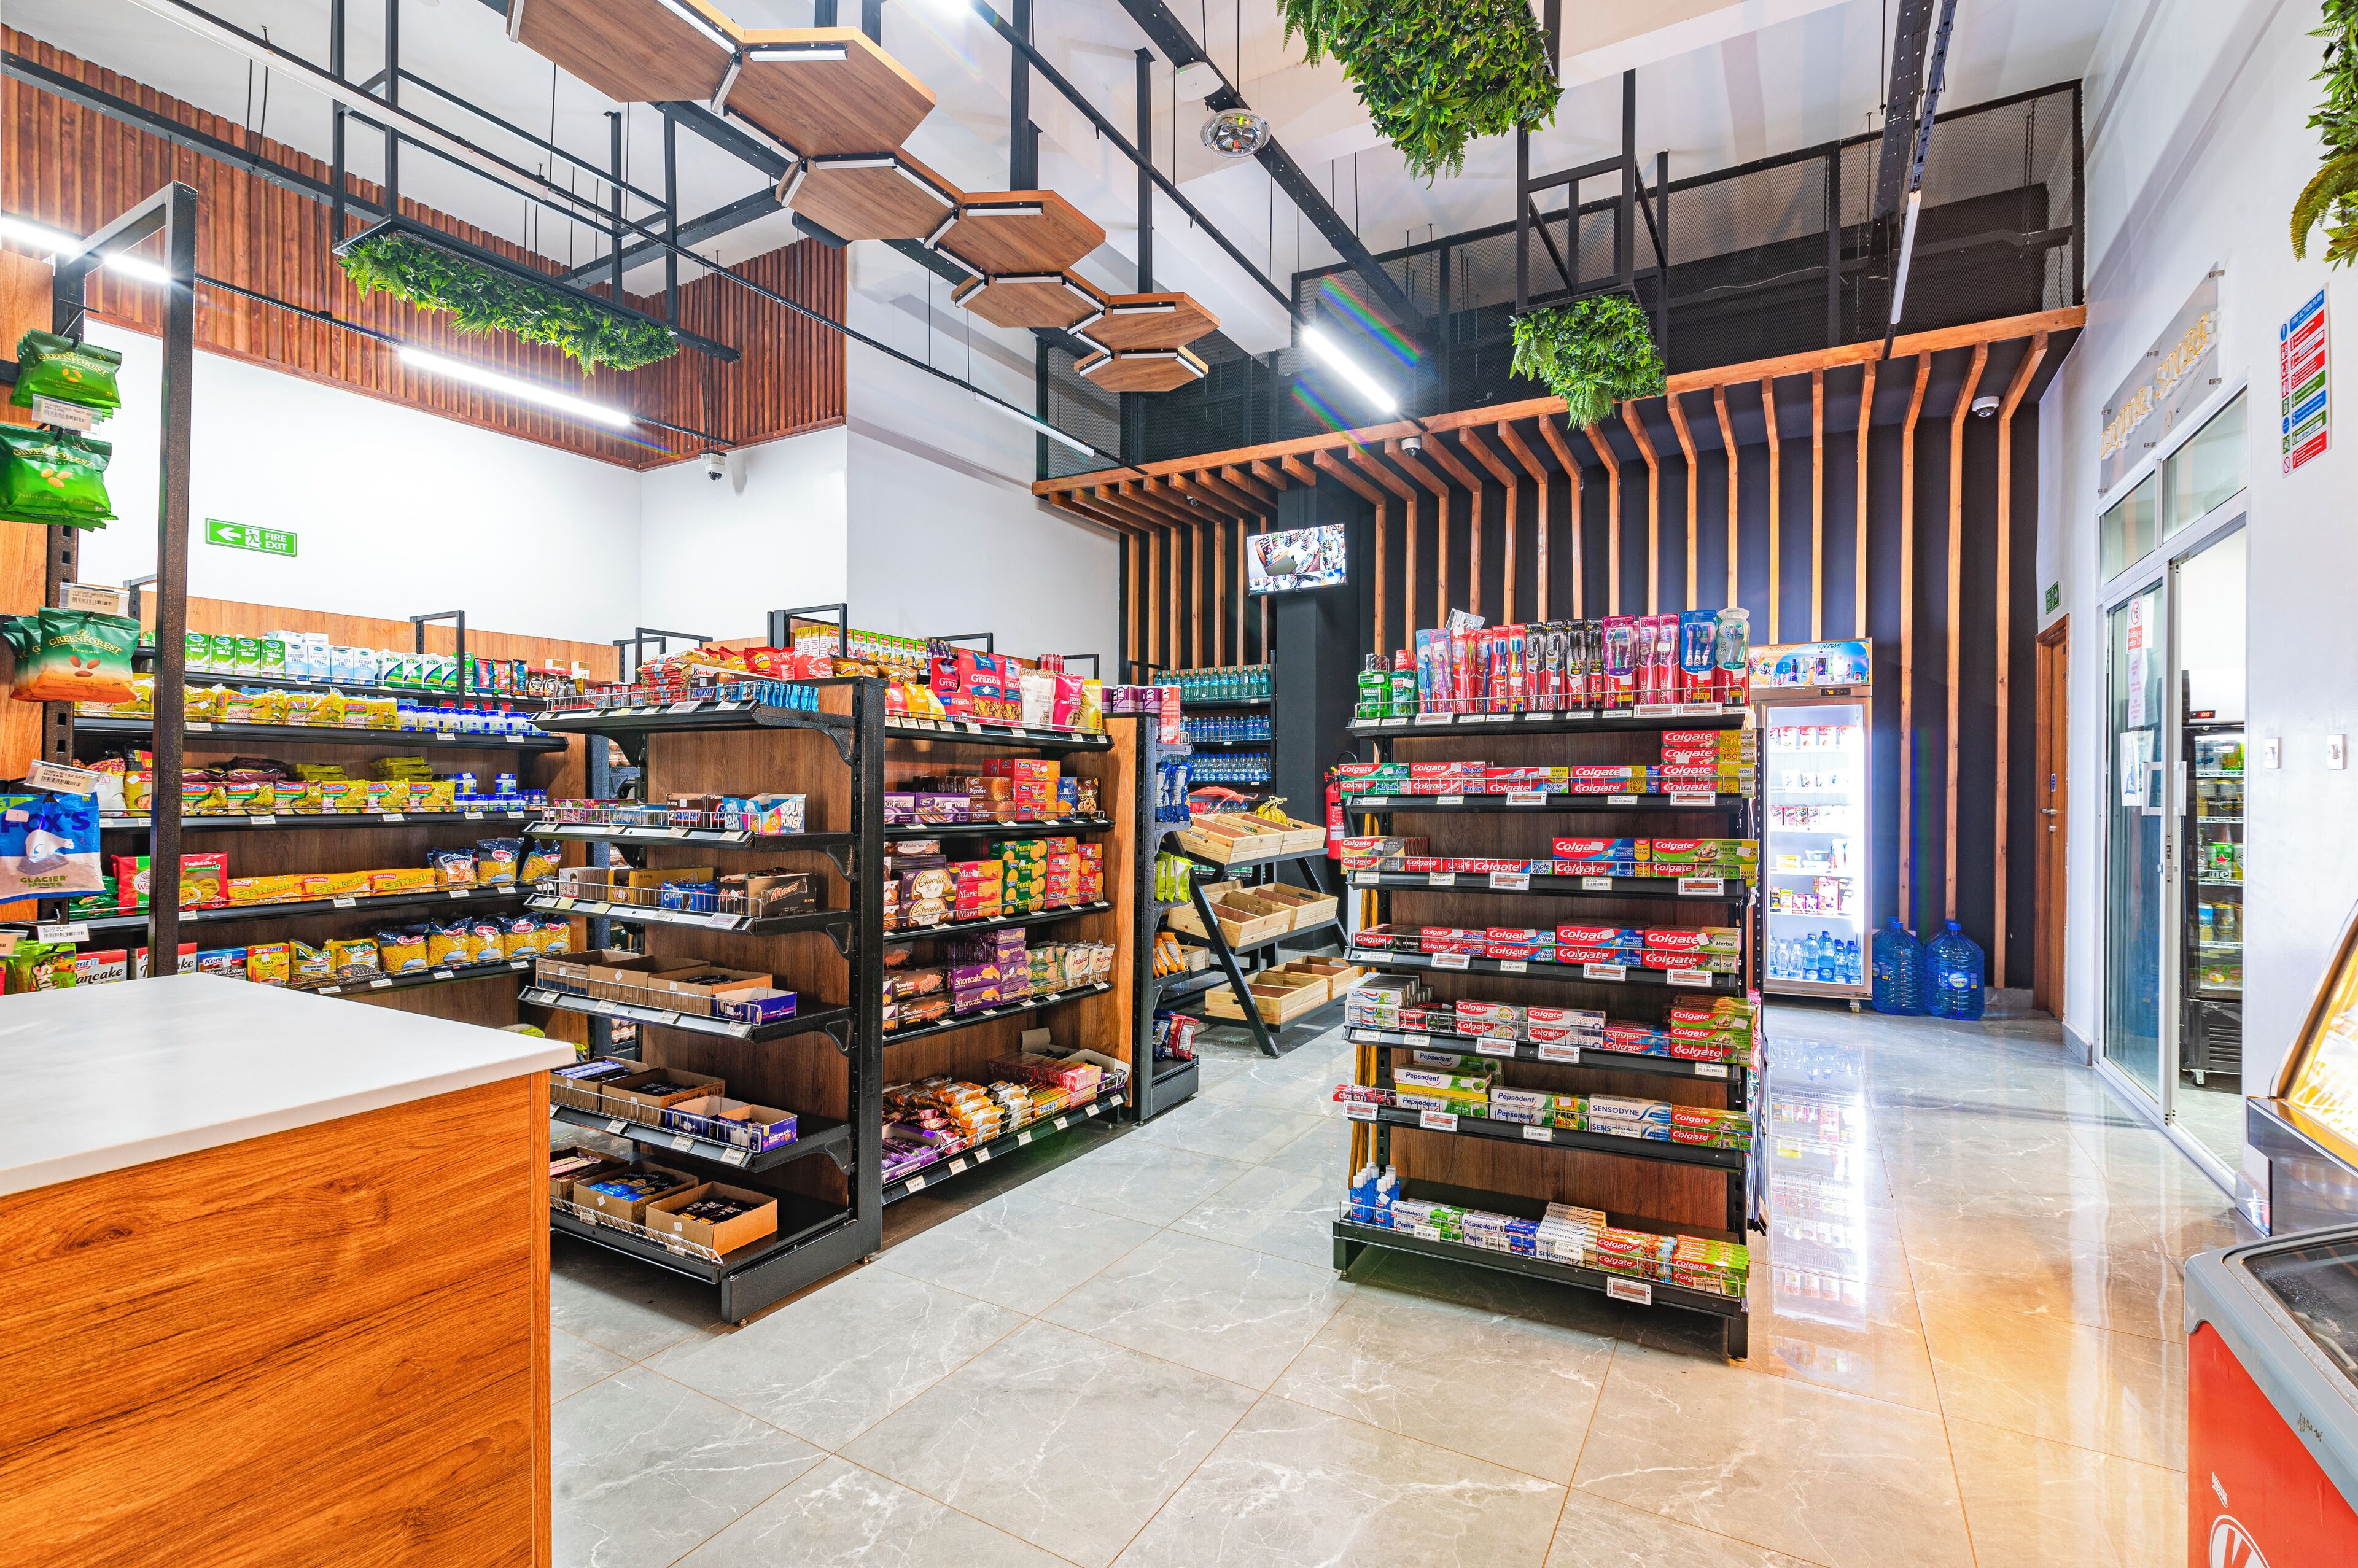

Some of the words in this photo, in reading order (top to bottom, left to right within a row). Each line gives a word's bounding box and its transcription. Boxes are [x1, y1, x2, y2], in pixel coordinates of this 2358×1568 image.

[2155, 311, 2218, 399] STORE
[38, 353, 109, 375] GREENFOREST
[265, 533, 287, 542] FIRE
[265, 541, 287, 550] EXIT
[49, 634, 122, 654] GREENFOREST
[1665, 732, 1714, 742] Colgate
[1342, 765, 1374, 775] Colgate
[1412, 764, 1447, 773] Colgate
[1665, 766, 1713, 775] Colgate
[781, 801, 803, 818] SOUR
[1, 812, 90, 833] FOX'S
[781, 817, 803, 829] POWER
[1655, 841, 1695, 850] Colgate
[383, 880, 401, 890] Egg
[917, 874, 946, 885] Chocolate
[313, 883, 332, 894] Egg
[771, 882, 799, 901] Mars
[664, 892, 682, 901] OREO
[913, 904, 942, 915] Chocolate
[955, 974, 982, 986] Shortcake
[957, 999, 982, 1009] Shortcake
[1458, 1003, 1488, 1012] Colgate
[1529, 1010, 1562, 1019] Colgate
[1673, 1012, 1710, 1021] Colgate
[1458, 1021, 1492, 1031] Colgate
[1570, 1034, 1602, 1044] SENSITIVE
[1420, 1052, 1452, 1063] Pepsodent
[1674, 1046, 1721, 1058] Colgate
[1406, 1071, 1440, 1082] Pepsodent
[1403, 1097, 1437, 1108] Pepsodent
[1498, 1092, 1535, 1103] Pepsodent
[1496, 1109, 1534, 1120] Pepsodent
[1555, 1108, 1576, 1119] PACK
[1593, 1105, 1640, 1116] SENSODYNE
[1675, 1114, 1710, 1124] Colgate
[1393, 1207, 1423, 1217] Pepsodent
[1550, 1202, 1585, 1213] SENSODYNE
[1546, 1214, 1583, 1224] SENSODYNE
[1548, 1208, 1585, 1219] SENSODYNE
[1463, 1220, 1498, 1231] Pepsodent
[1544, 1219, 1581, 1229] SENSODYNE
[1541, 1225, 1579, 1235] SENSODYNE
[1598, 1239, 1632, 1251] Colgate
[1539, 1250, 1576, 1261] SENSODYNE
[1598, 1254, 1633, 1267] Colgate
[1675, 1259, 1708, 1271] Colgate
